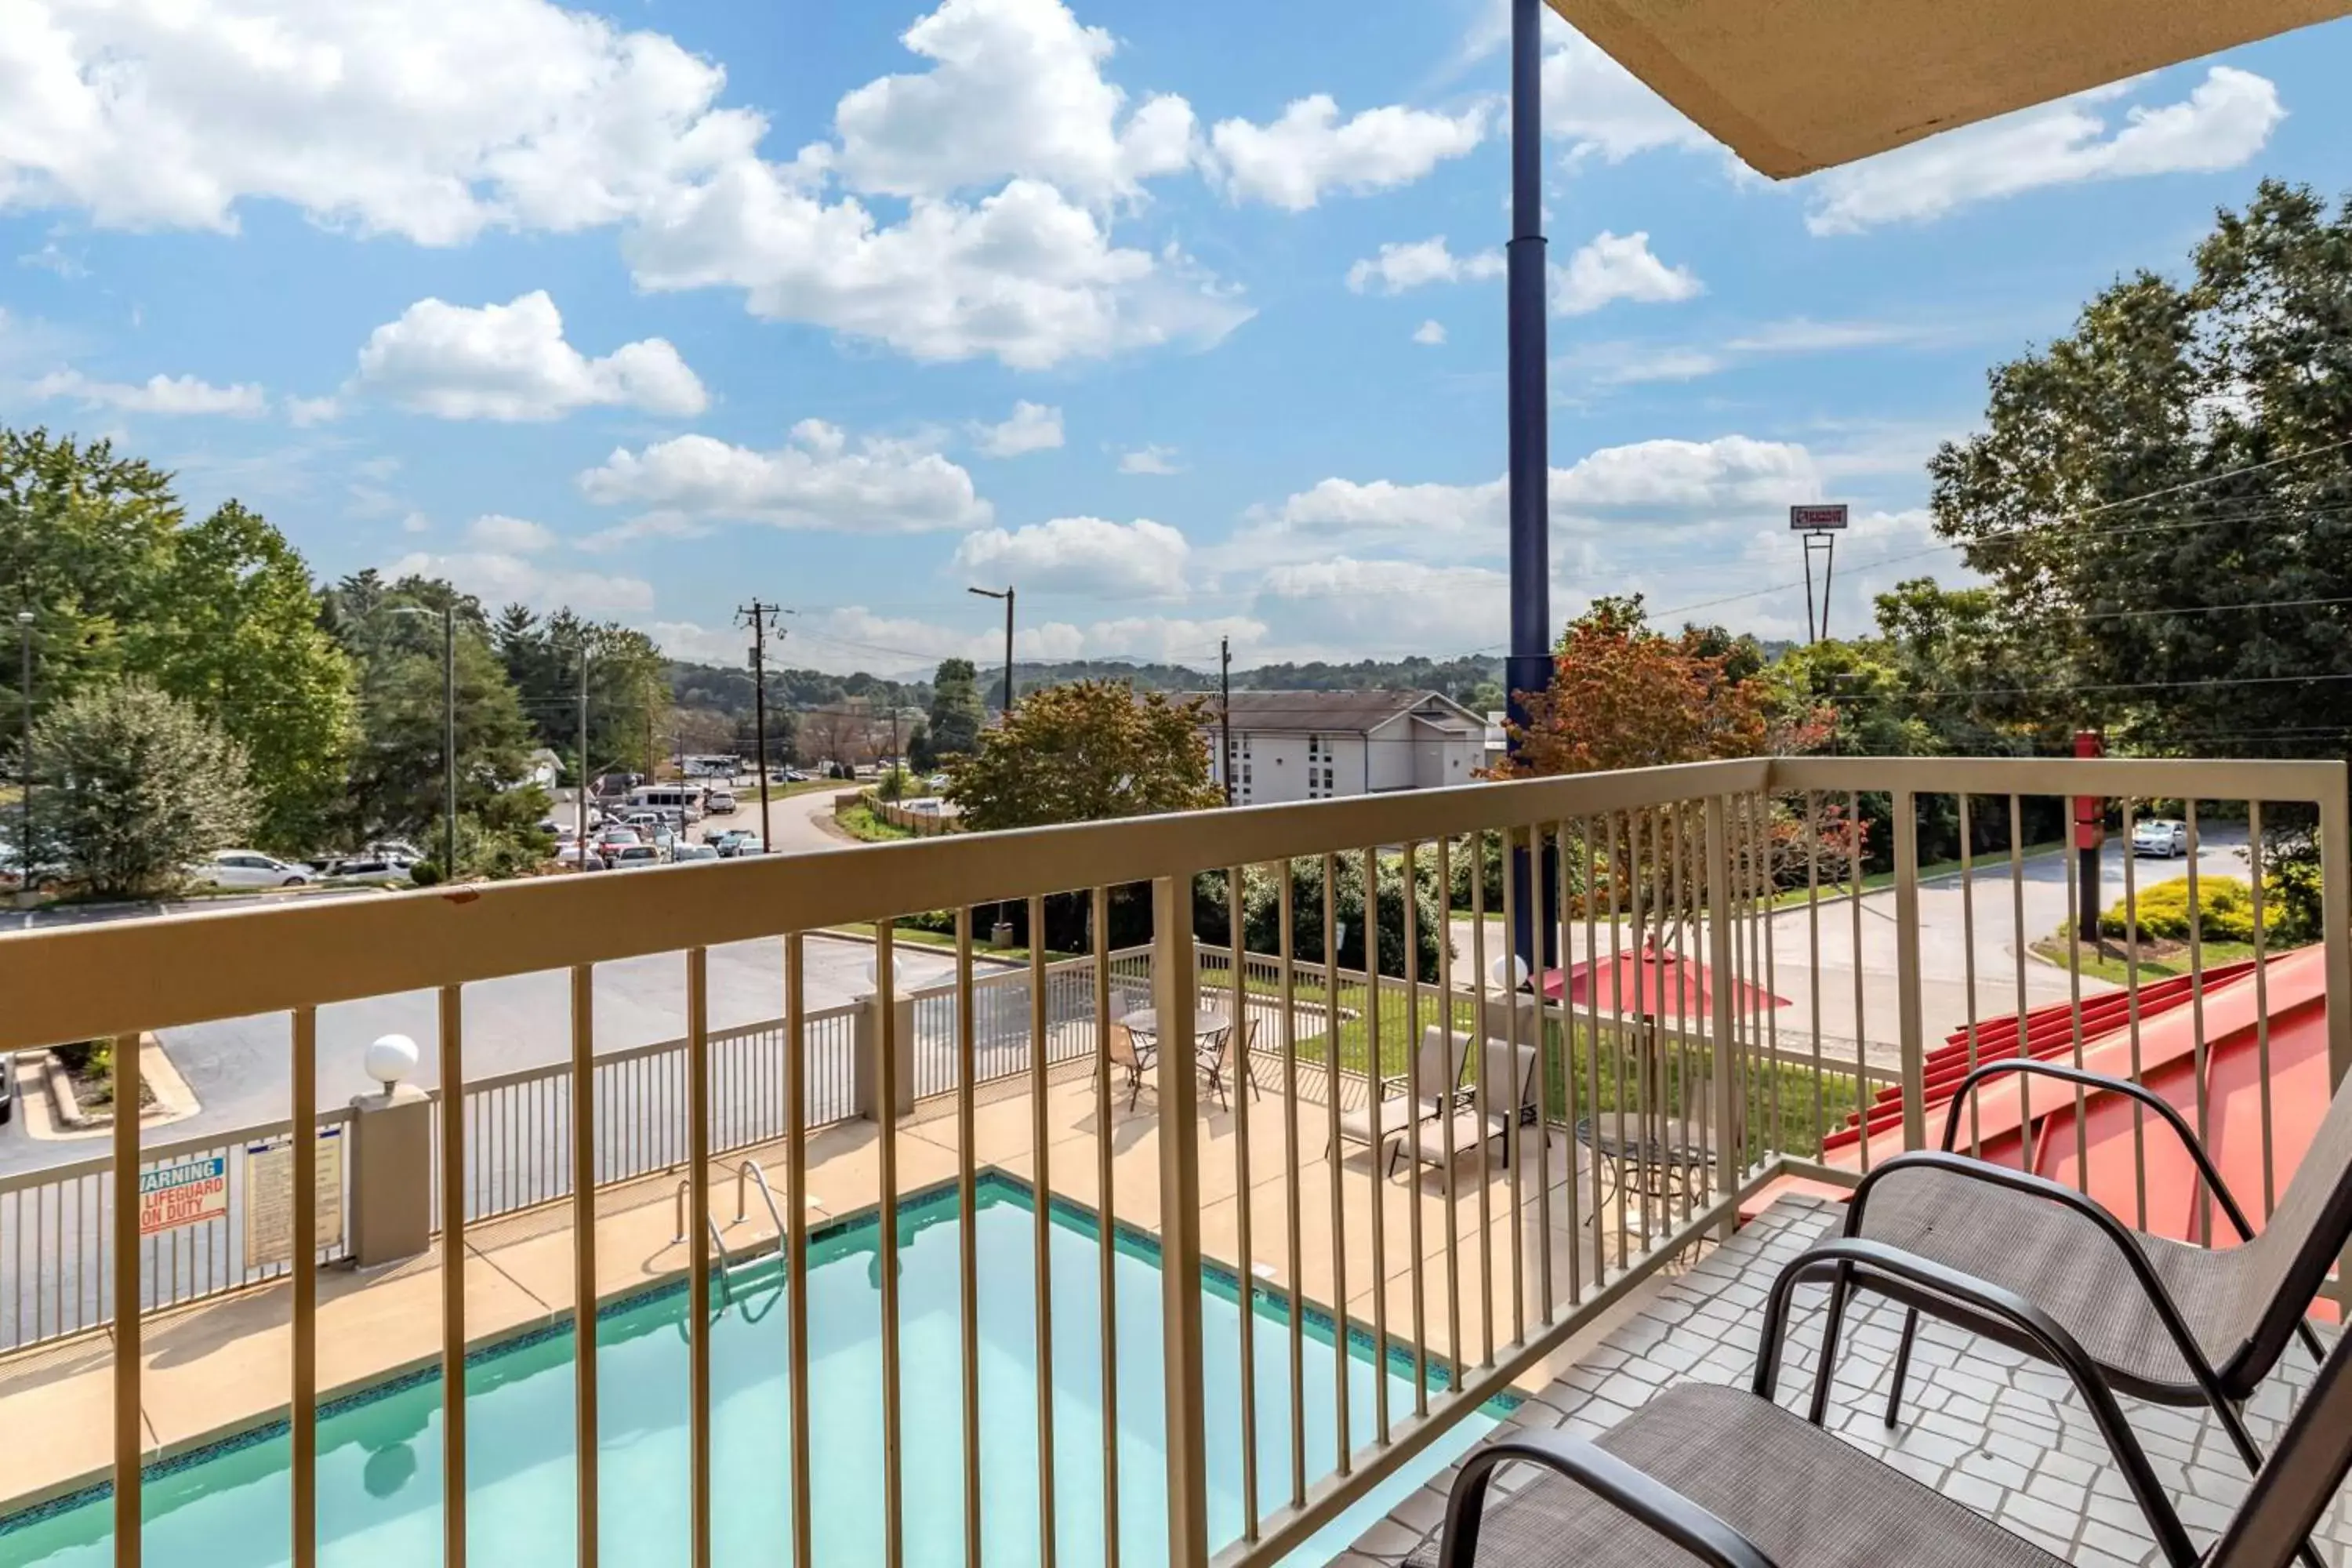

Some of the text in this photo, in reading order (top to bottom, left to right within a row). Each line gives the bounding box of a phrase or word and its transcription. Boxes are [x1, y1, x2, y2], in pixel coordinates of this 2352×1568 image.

[145, 1177, 223, 1209] LIFEGUARD
[142, 1196, 203, 1225] ON DUTY
